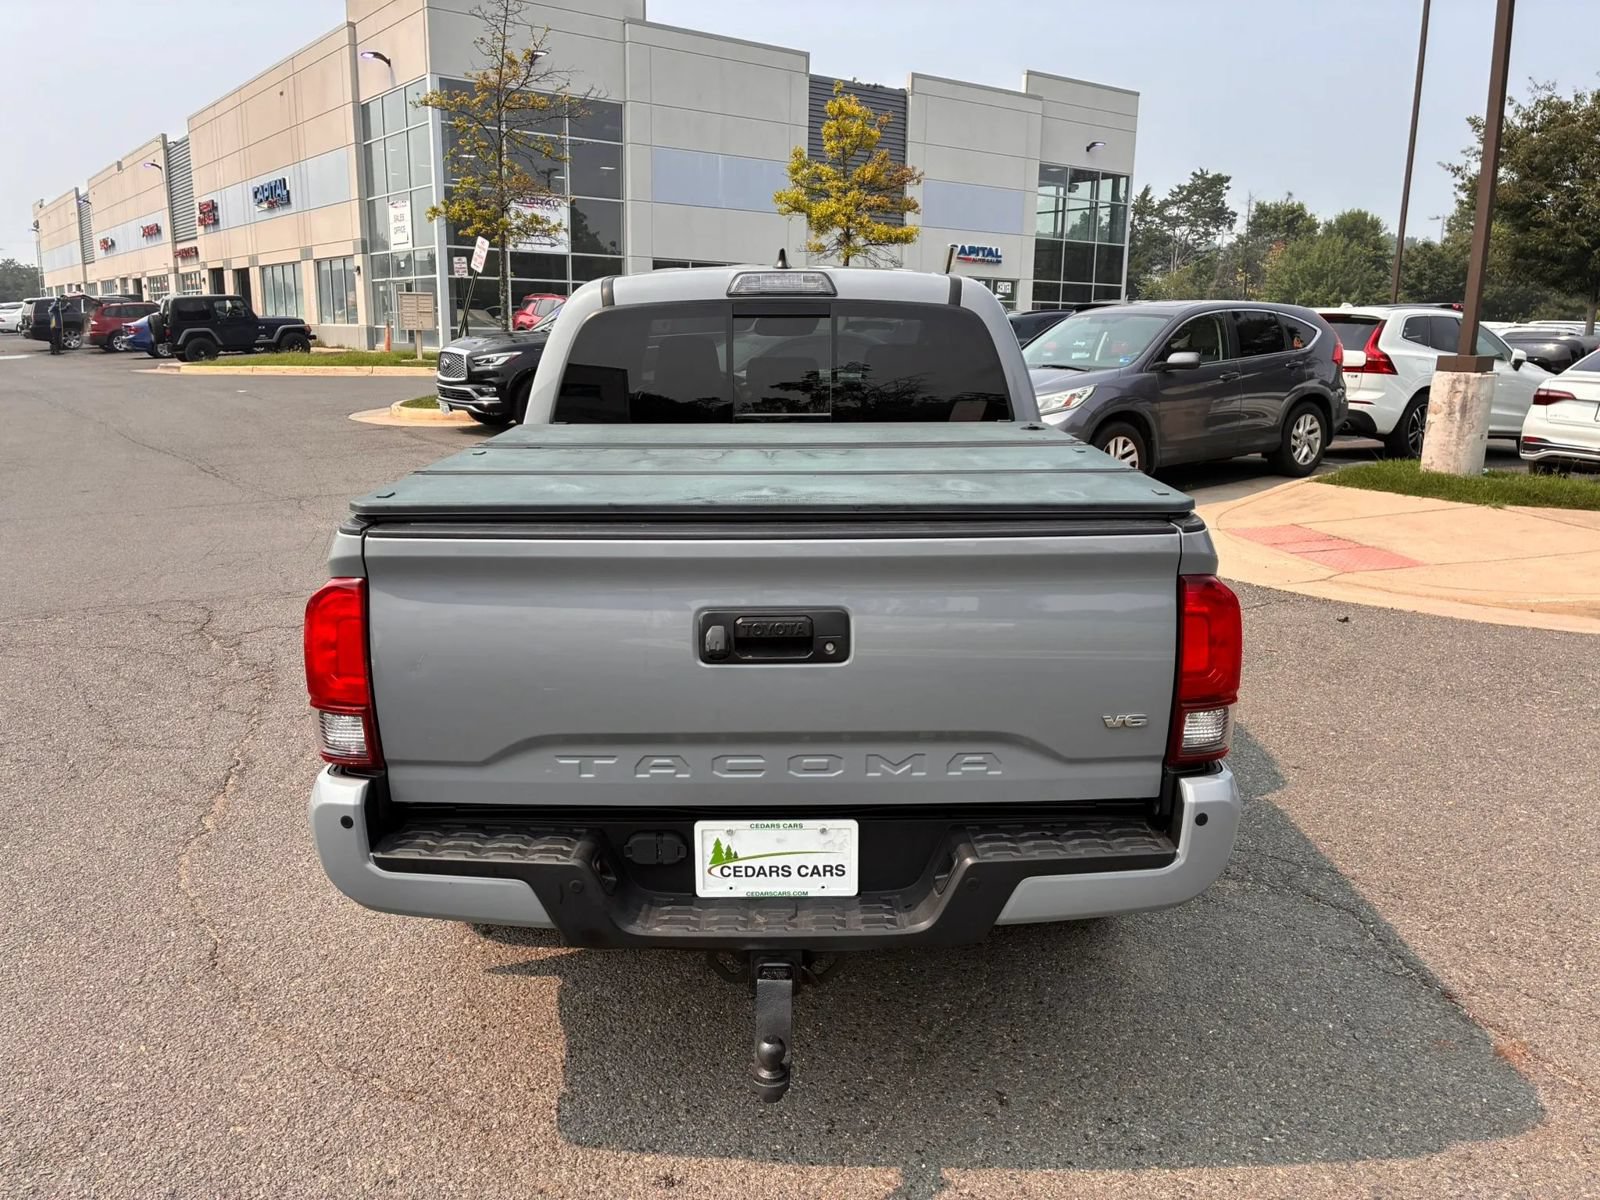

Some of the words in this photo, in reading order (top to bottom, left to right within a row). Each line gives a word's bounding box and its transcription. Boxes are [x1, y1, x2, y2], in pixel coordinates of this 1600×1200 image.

[252, 177, 288, 203] CAPITAL
[741, 622, 806, 636] TOYOTA
[1102, 713, 1148, 728] V6
[554, 752, 1003, 778] TACOMA
[720, 865, 792, 878] CEDARS
[797, 864, 846, 877] CARS
